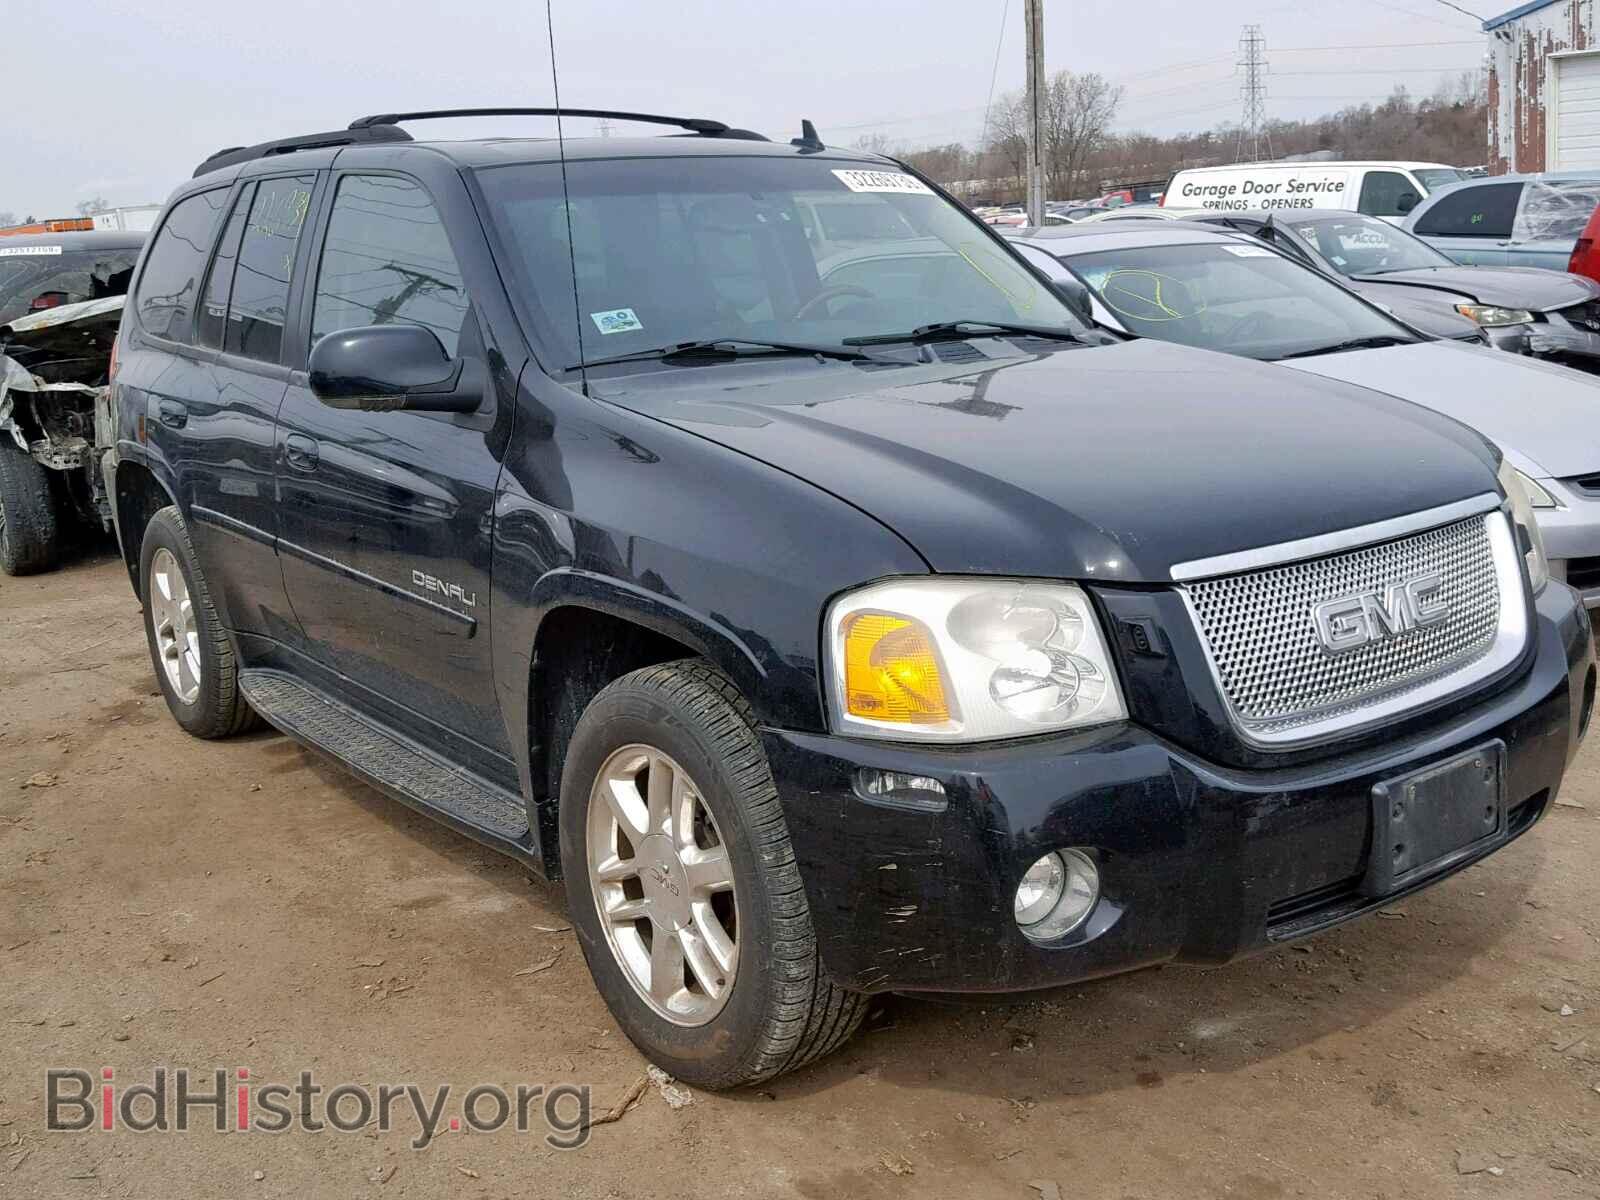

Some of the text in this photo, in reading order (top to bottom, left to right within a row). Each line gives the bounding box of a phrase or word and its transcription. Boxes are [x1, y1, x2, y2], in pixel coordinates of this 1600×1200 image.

[1182, 178, 1344, 198] Garage Door Service
[1202, 200, 1248, 210] SPRINGS
[1261, 198, 1313, 210] OPENERS
[412, 569, 476, 607] DENALI
[1312, 572, 1450, 651] GMC
